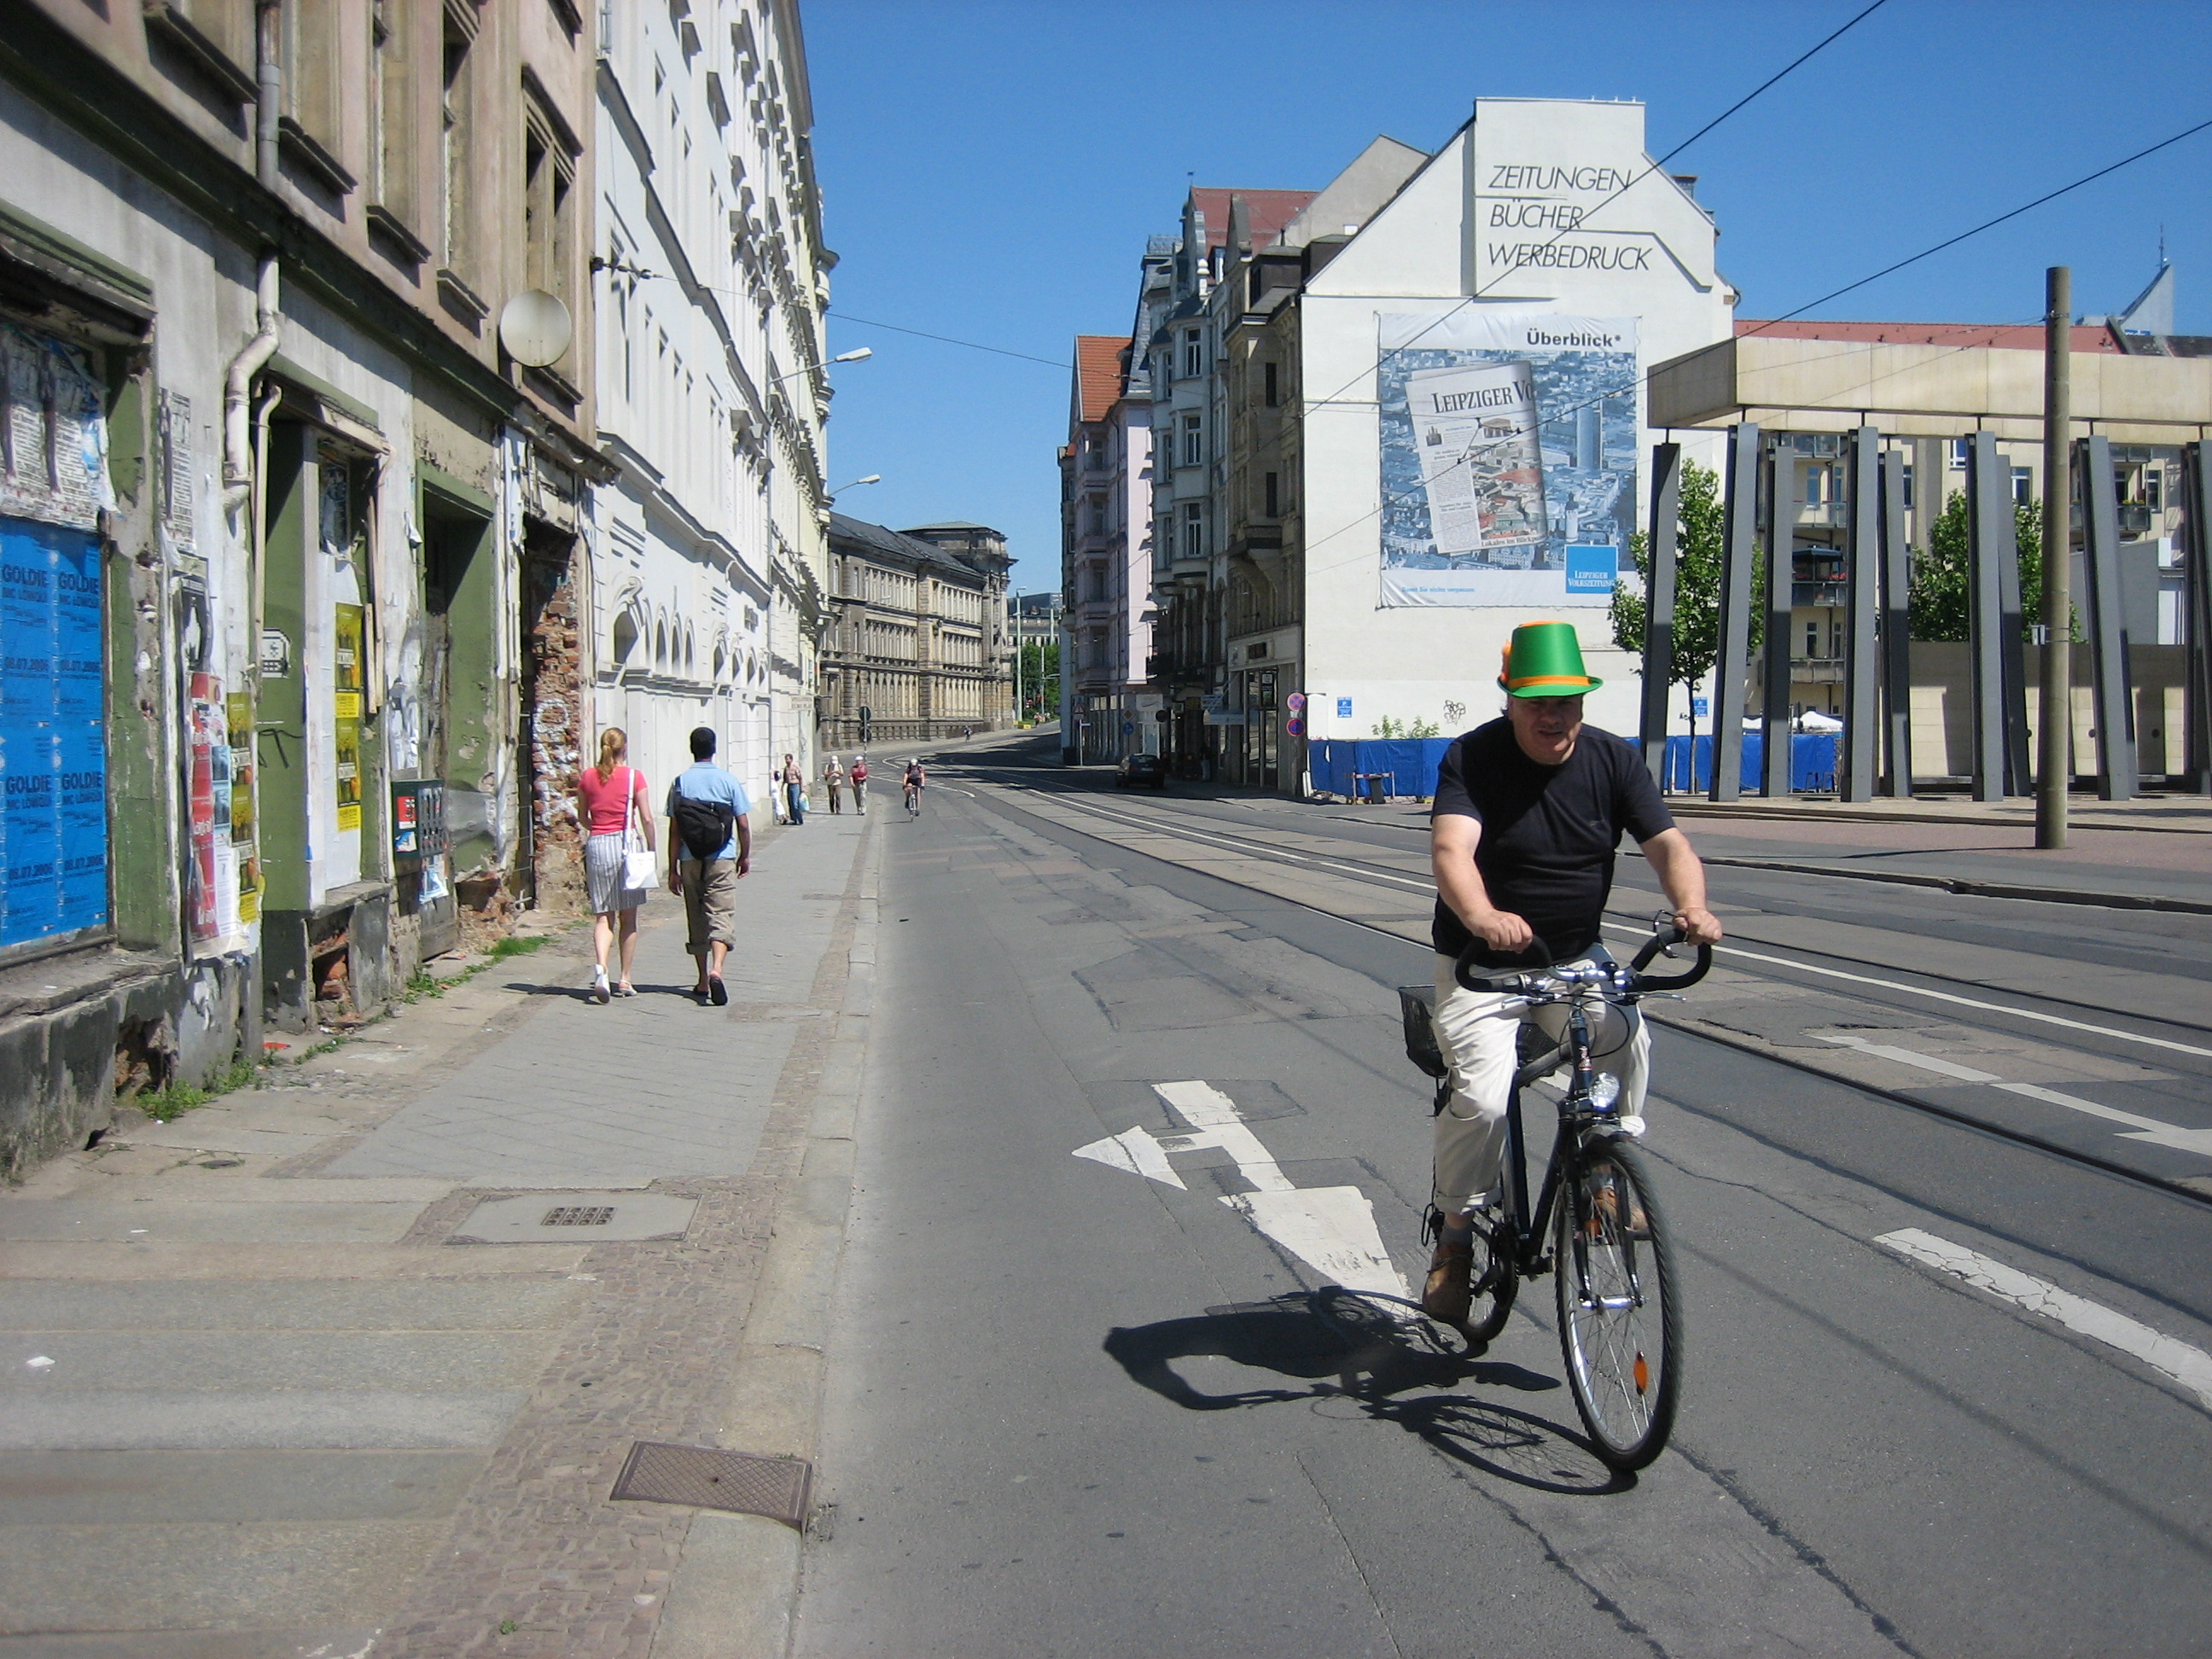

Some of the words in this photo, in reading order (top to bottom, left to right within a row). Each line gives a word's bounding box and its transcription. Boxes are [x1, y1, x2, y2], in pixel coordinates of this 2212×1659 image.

[1488, 166, 1632, 191] ZEITUNGEN
[1489, 199, 1584, 230] BÜCHER
[1488, 243, 1653, 271] WERBEDRUCK
[1431, 387, 1514, 413] LEIPZIGER
[3, 564, 48, 588] GOLDIE
[59, 573, 99, 594] GOLDIE
[6, 775, 52, 795] GOLDIE
[62, 771, 102, 790] GOLDIE
